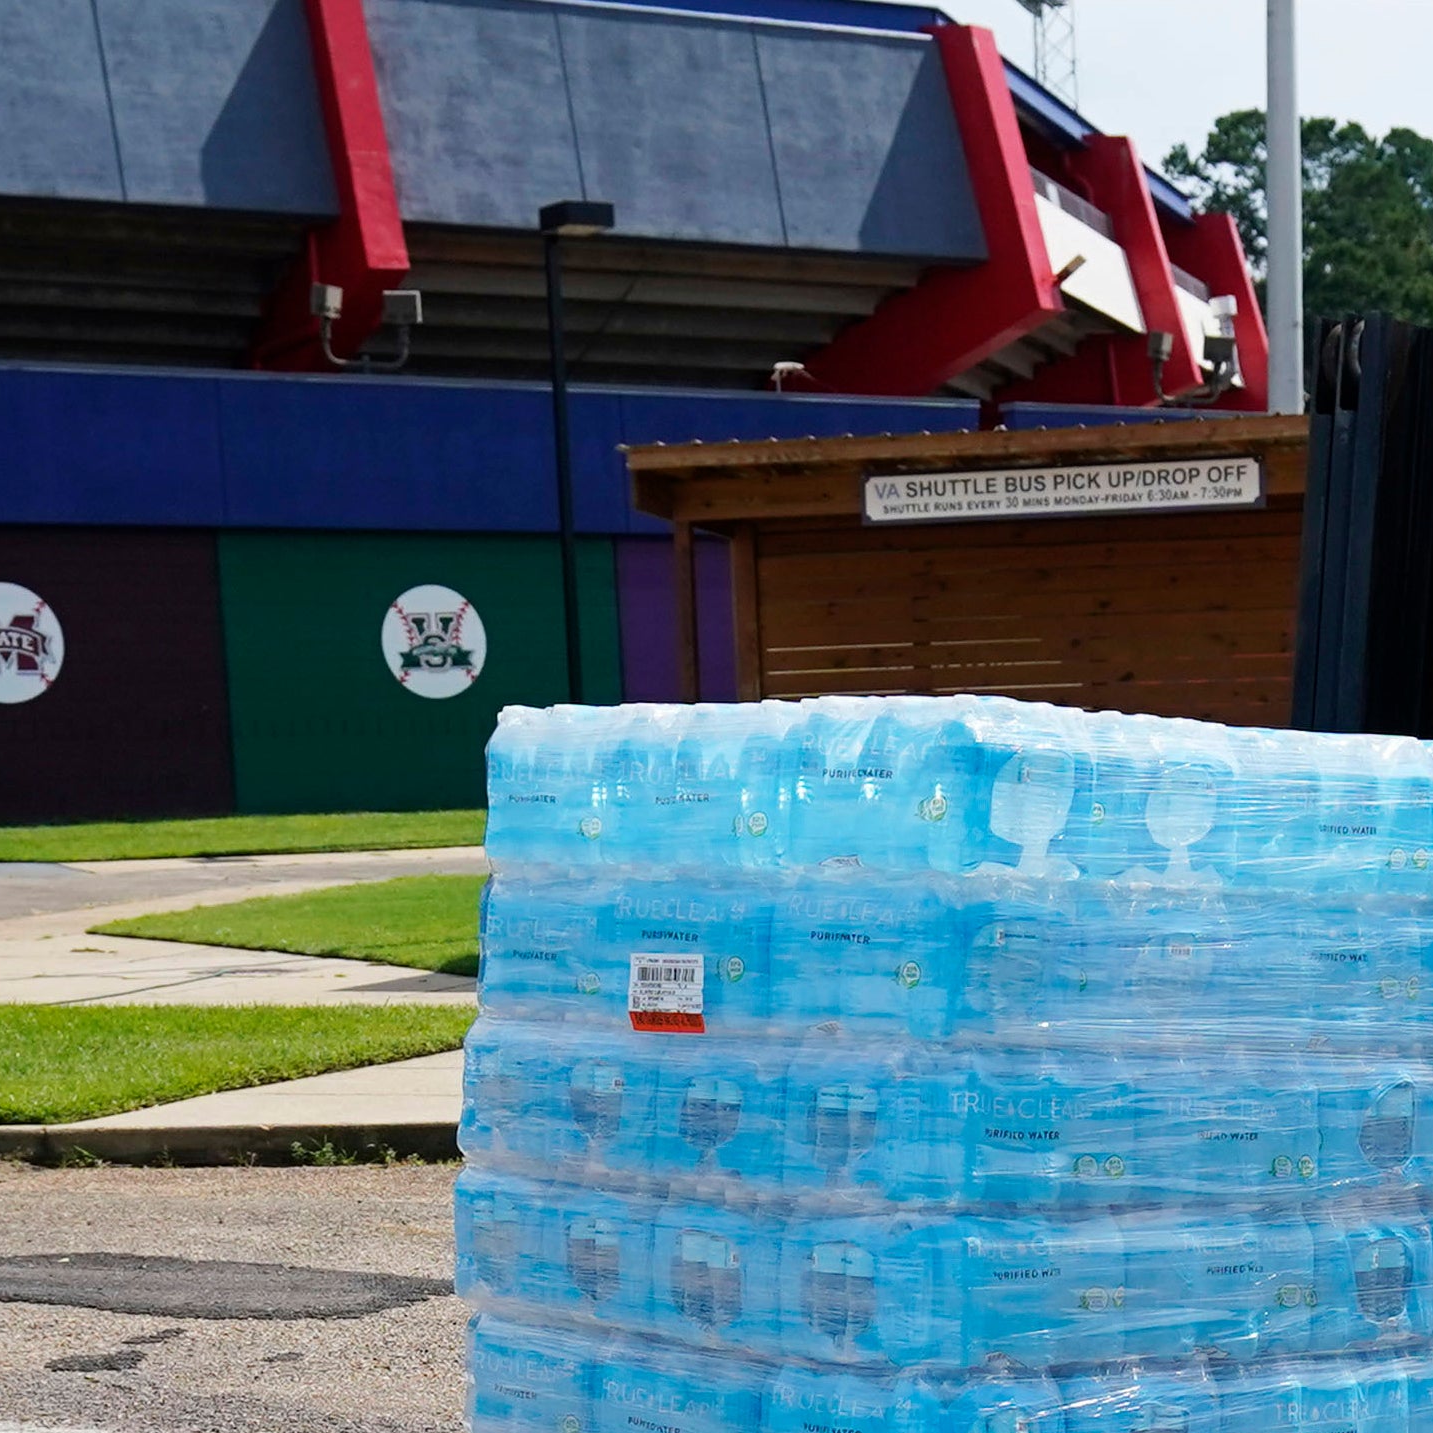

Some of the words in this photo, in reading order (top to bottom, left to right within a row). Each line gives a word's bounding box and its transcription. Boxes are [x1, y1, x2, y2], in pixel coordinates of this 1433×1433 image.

[874, 482, 900, 499] VA
[906, 477, 997, 498] SHUTTLE
[1005, 475, 1046, 493] BUS
[1052, 471, 1102, 490] PICK
[1108, 467, 1200, 488] UP/DROP
[1207, 465, 1248, 483] OFF
[883, 502, 929, 514] SHUTTLE
[933, 500, 963, 512] RUNS
[967, 498, 1001, 511] EVERY
[1005, 496, 1019, 509] 30
[1022, 495, 1050, 507] MINS
[1053, 492, 1144, 507] MONDAY-FRIDAY
[1147, 489, 1189, 503] 6:30AM
[1201, 486, 1243, 500] 7:30PM
[951, 1091, 1006, 1119] TRUE
[1028, 1129, 1060, 1141] WATER
[993, 1269, 1039, 1281] PURIFIED
[895, 1397, 913, 1411] 24
